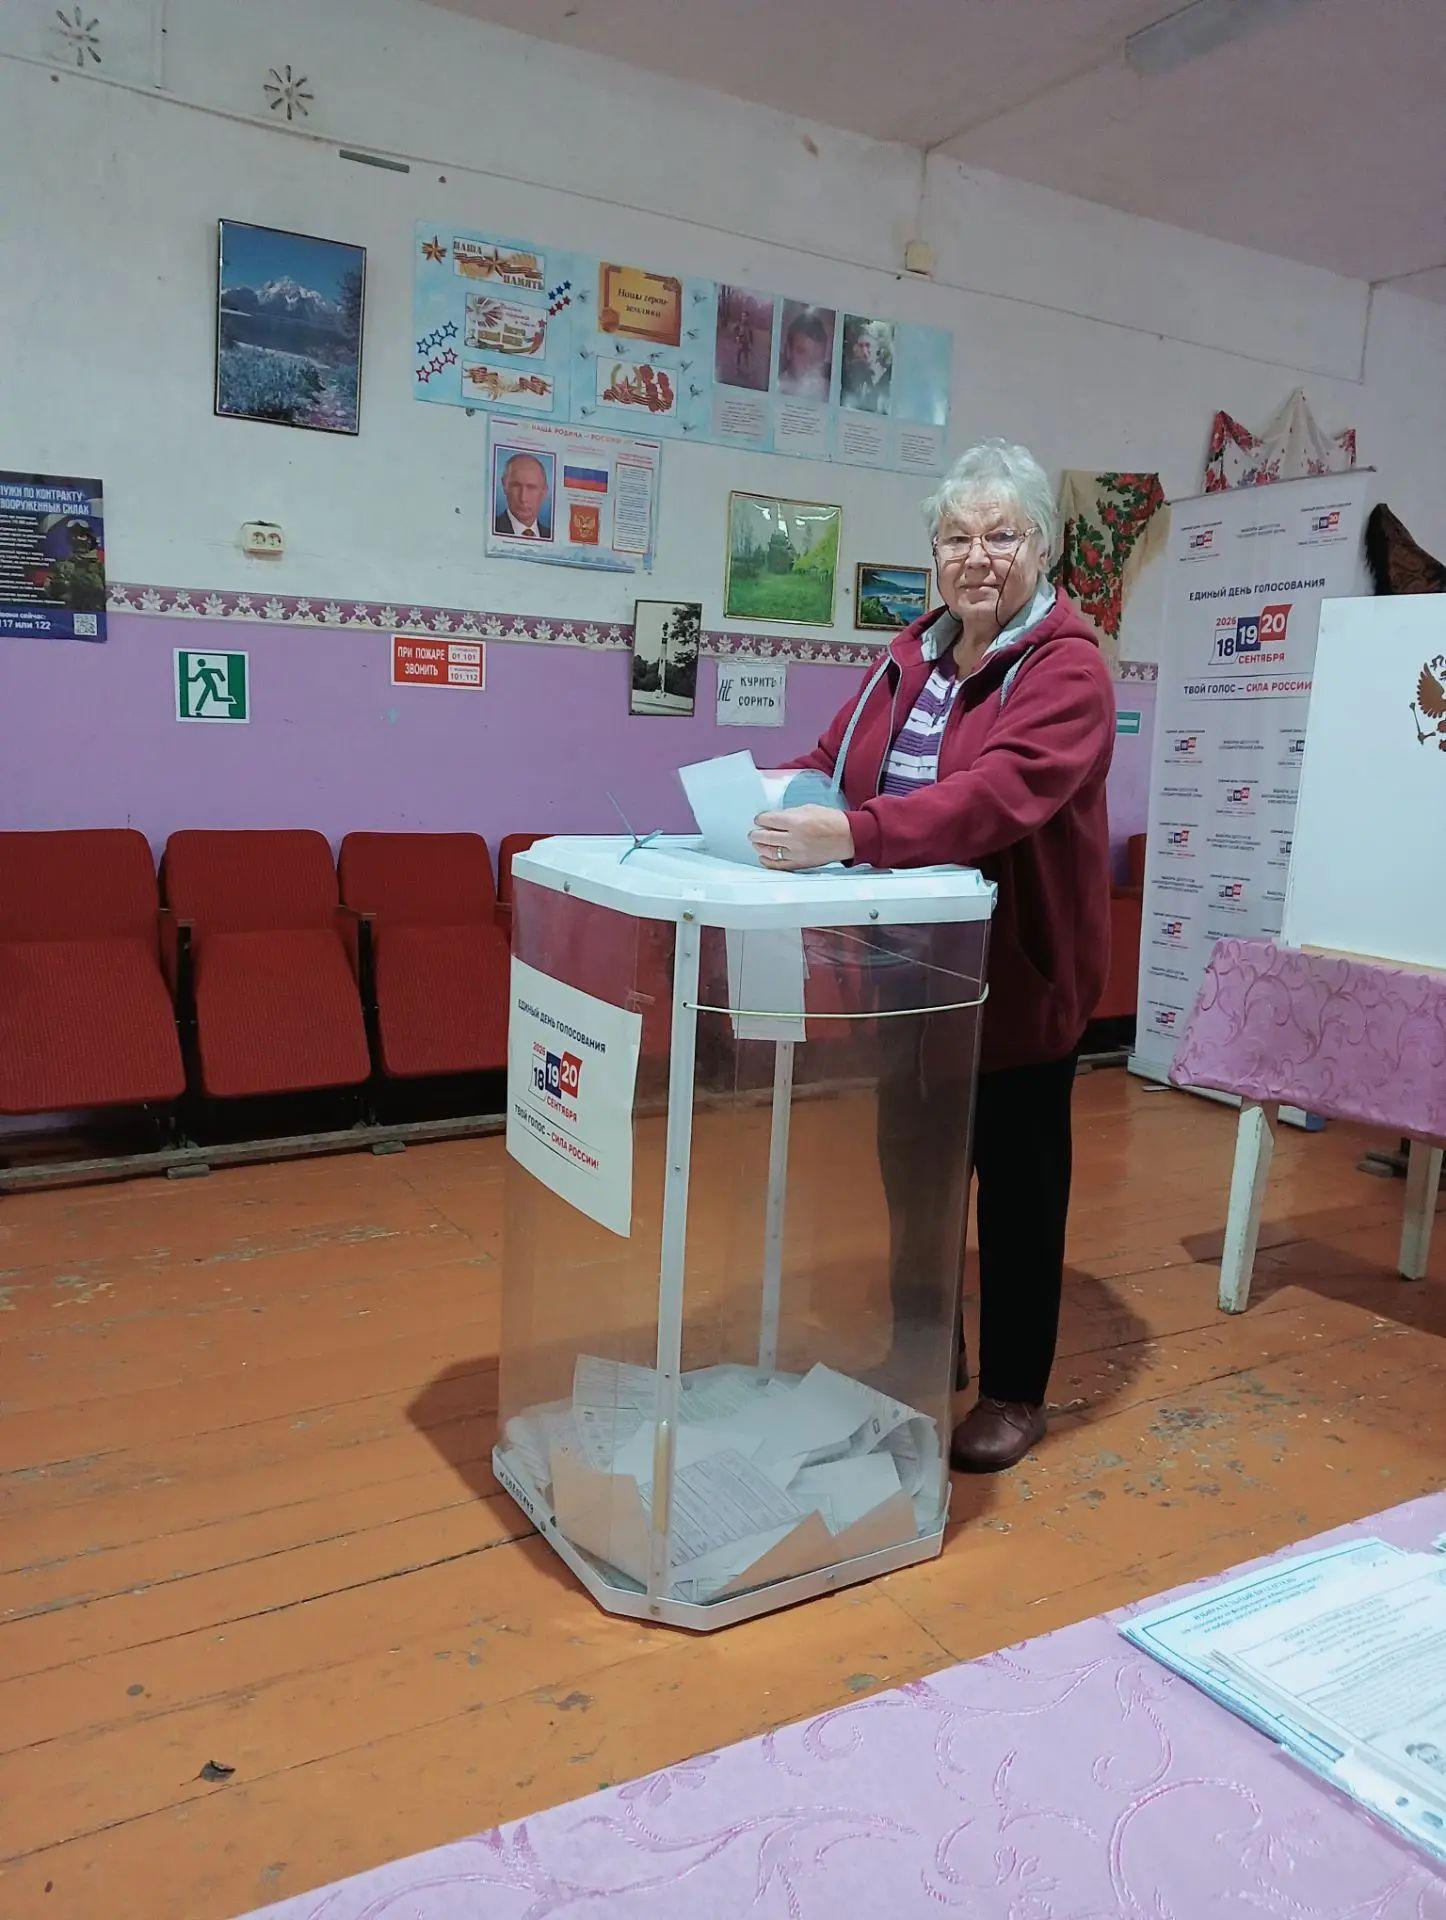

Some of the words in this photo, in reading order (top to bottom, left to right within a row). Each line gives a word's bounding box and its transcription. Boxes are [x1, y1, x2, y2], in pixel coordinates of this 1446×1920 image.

[453, 240, 482, 255] НАША
[503, 274, 544, 291] ПАМЯТЬ
[554, 427, 582, 438] РОДИНА
[23, 487, 34, 499] ПО
[35, 488, 83, 502] КОНТРАКТУ
[62, 503, 89, 515] СИЛАХ
[1189, 586, 1227, 601] ЕДИНЫЙ
[1228, 586, 1252, 597] ДЕНЬ
[1254, 578, 1326, 594] ГОЛОСОВАНИЯ
[35, 620, 51, 631] 122
[1216, 617, 1237, 627] 2026
[1216, 638, 1235, 657] 18
[1239, 625, 1258, 645] 19
[1260, 613, 1286, 634] 20
[397, 646, 412, 658] ПРИ
[415, 647, 446, 660] ПОЖАРЕ
[1238, 653, 1285, 664] СЕНТЯБРЯ
[404, 662, 439, 676] ЗВОНИТЬ
[717, 679, 734, 702] НЕ
[1184, 684, 1206, 695] ТВОЙ
[1207, 684, 1236, 694] ГОЛОС
[1246, 683, 1269, 692] СИЛА
[518, 998, 540, 1019] ЕДИНЫЙ
[540, 1012, 556, 1029] ДЕНЬ
[556, 1020, 606, 1054] ГОЛОСОВАНИЯ
[533, 1066, 545, 1091] 18
[547, 1062, 559, 1088] 19
[561, 1060, 578, 1088] 20
[546, 1096, 577, 1122] СЕНТЯБРЯ
[514, 1104, 528, 1120] ТВОЙ
[527, 1114, 546, 1135] ГОЛОС
[551, 1132, 567, 1149] СИЛА
[568, 1143, 599, 1170] РОССИИ!
